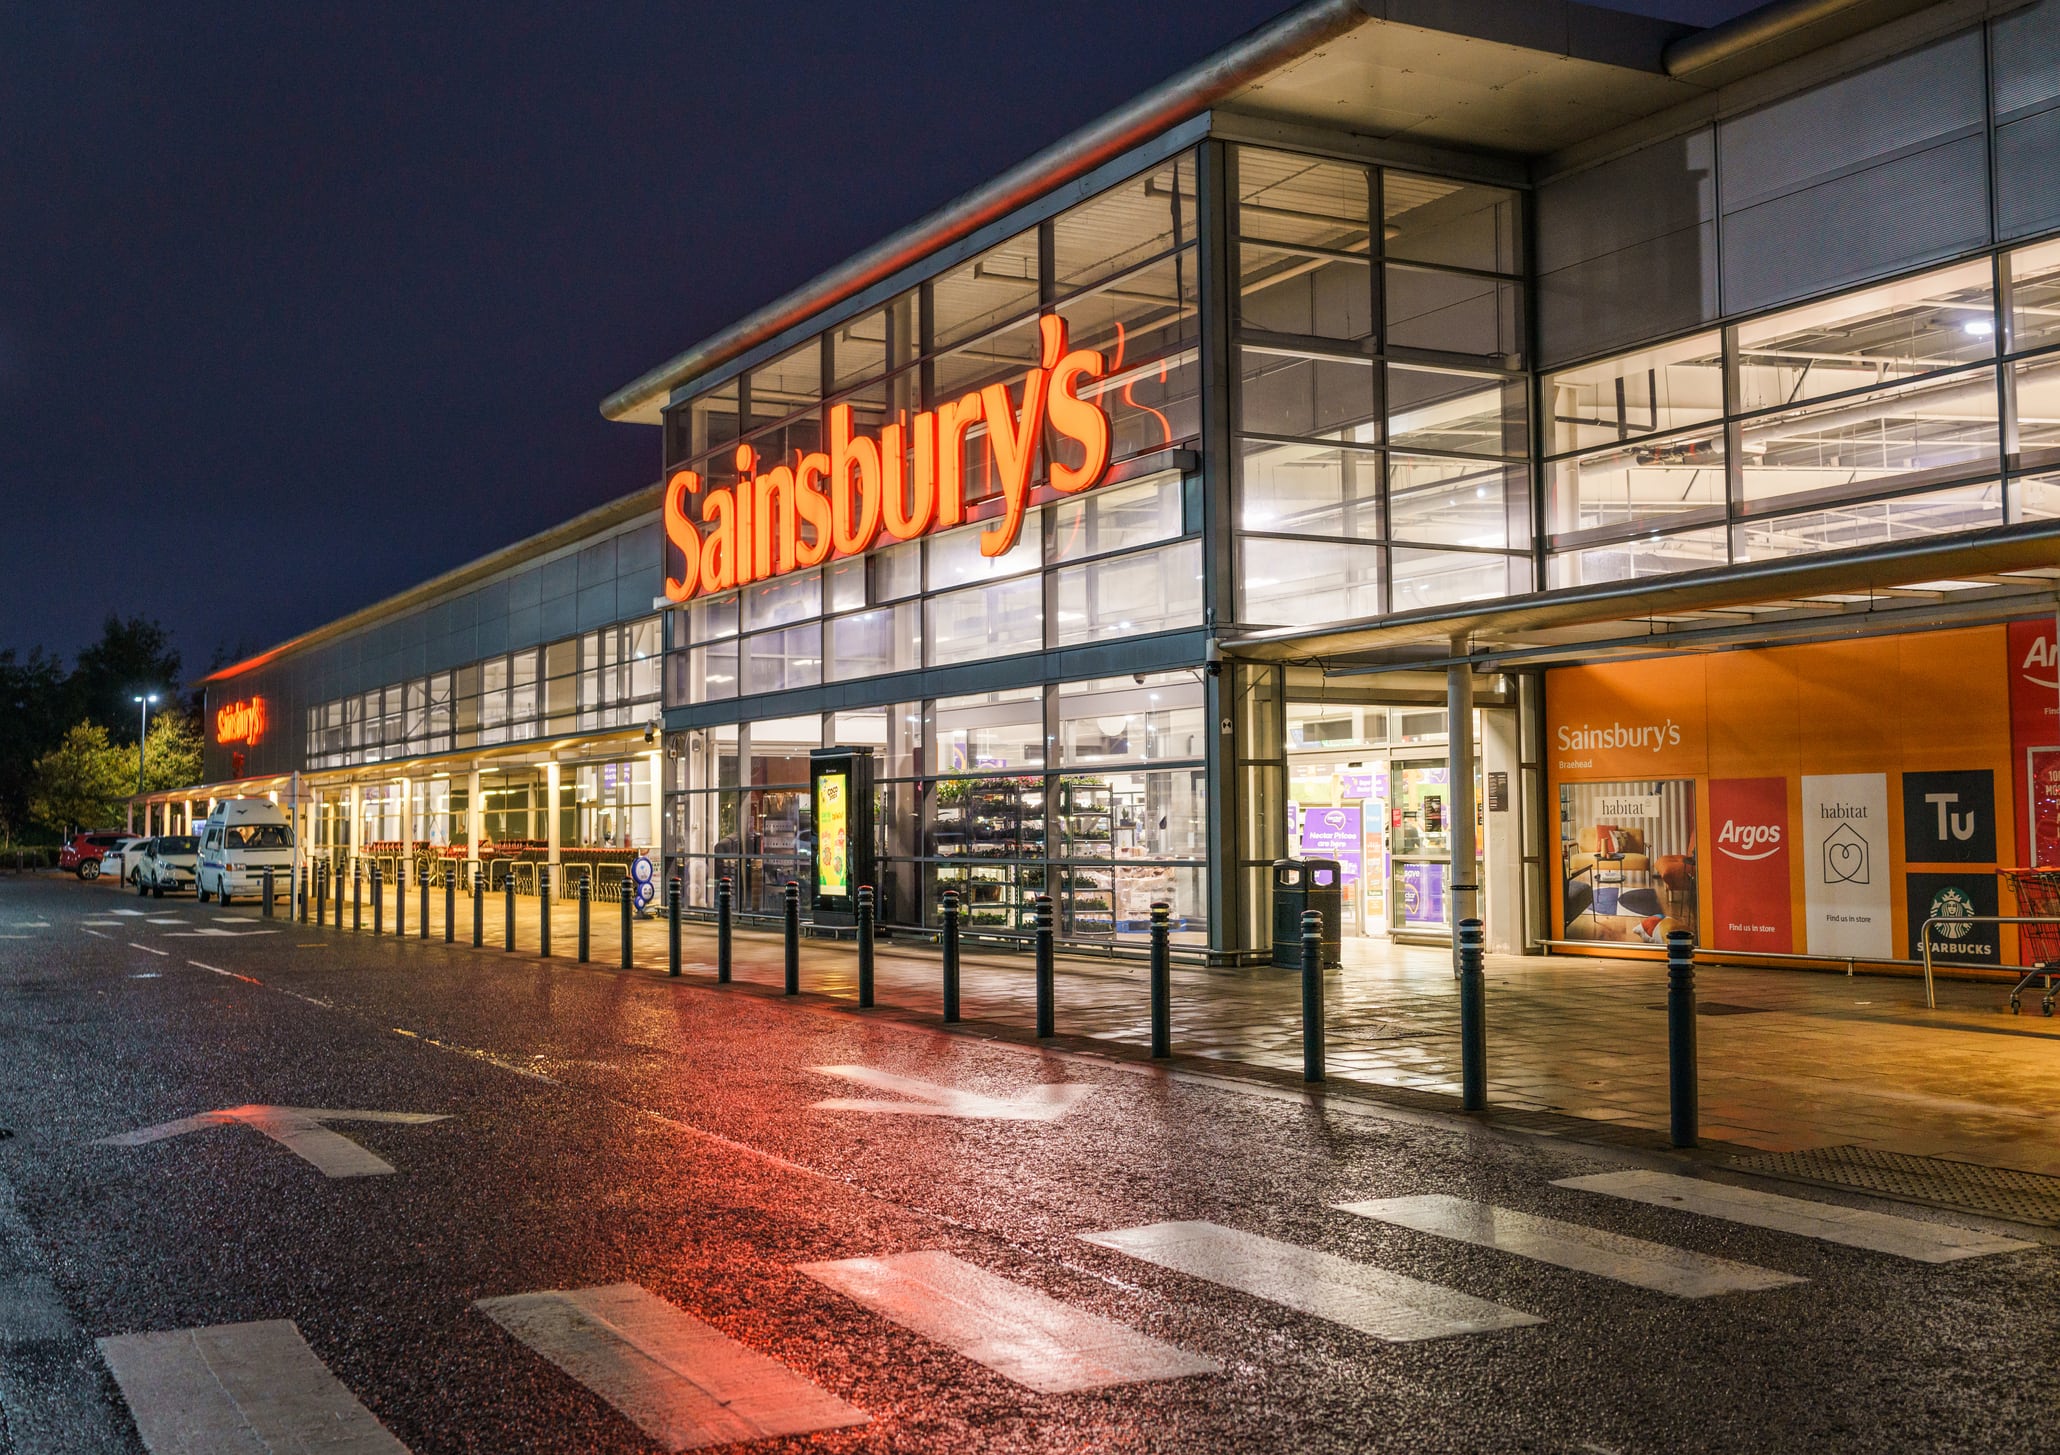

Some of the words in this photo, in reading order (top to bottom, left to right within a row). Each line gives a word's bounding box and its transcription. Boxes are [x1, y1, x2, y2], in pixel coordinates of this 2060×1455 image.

[665, 314, 1112, 602] Sainsbury's
[1558, 719, 1680, 752] Sainsbury's
[1559, 759, 1592, 769] Braehead
[1602, 800, 1644, 815] habitat
[1821, 803, 1869, 819] habitat
[1925, 792, 1975, 841] Tu
[1309, 832, 1333, 840] Nectar
[1334, 832, 1357, 840] Prices
[1718, 820, 1781, 849] Argos
[1855, 915, 1871, 923] store
[1759, 925, 1775, 933] store
